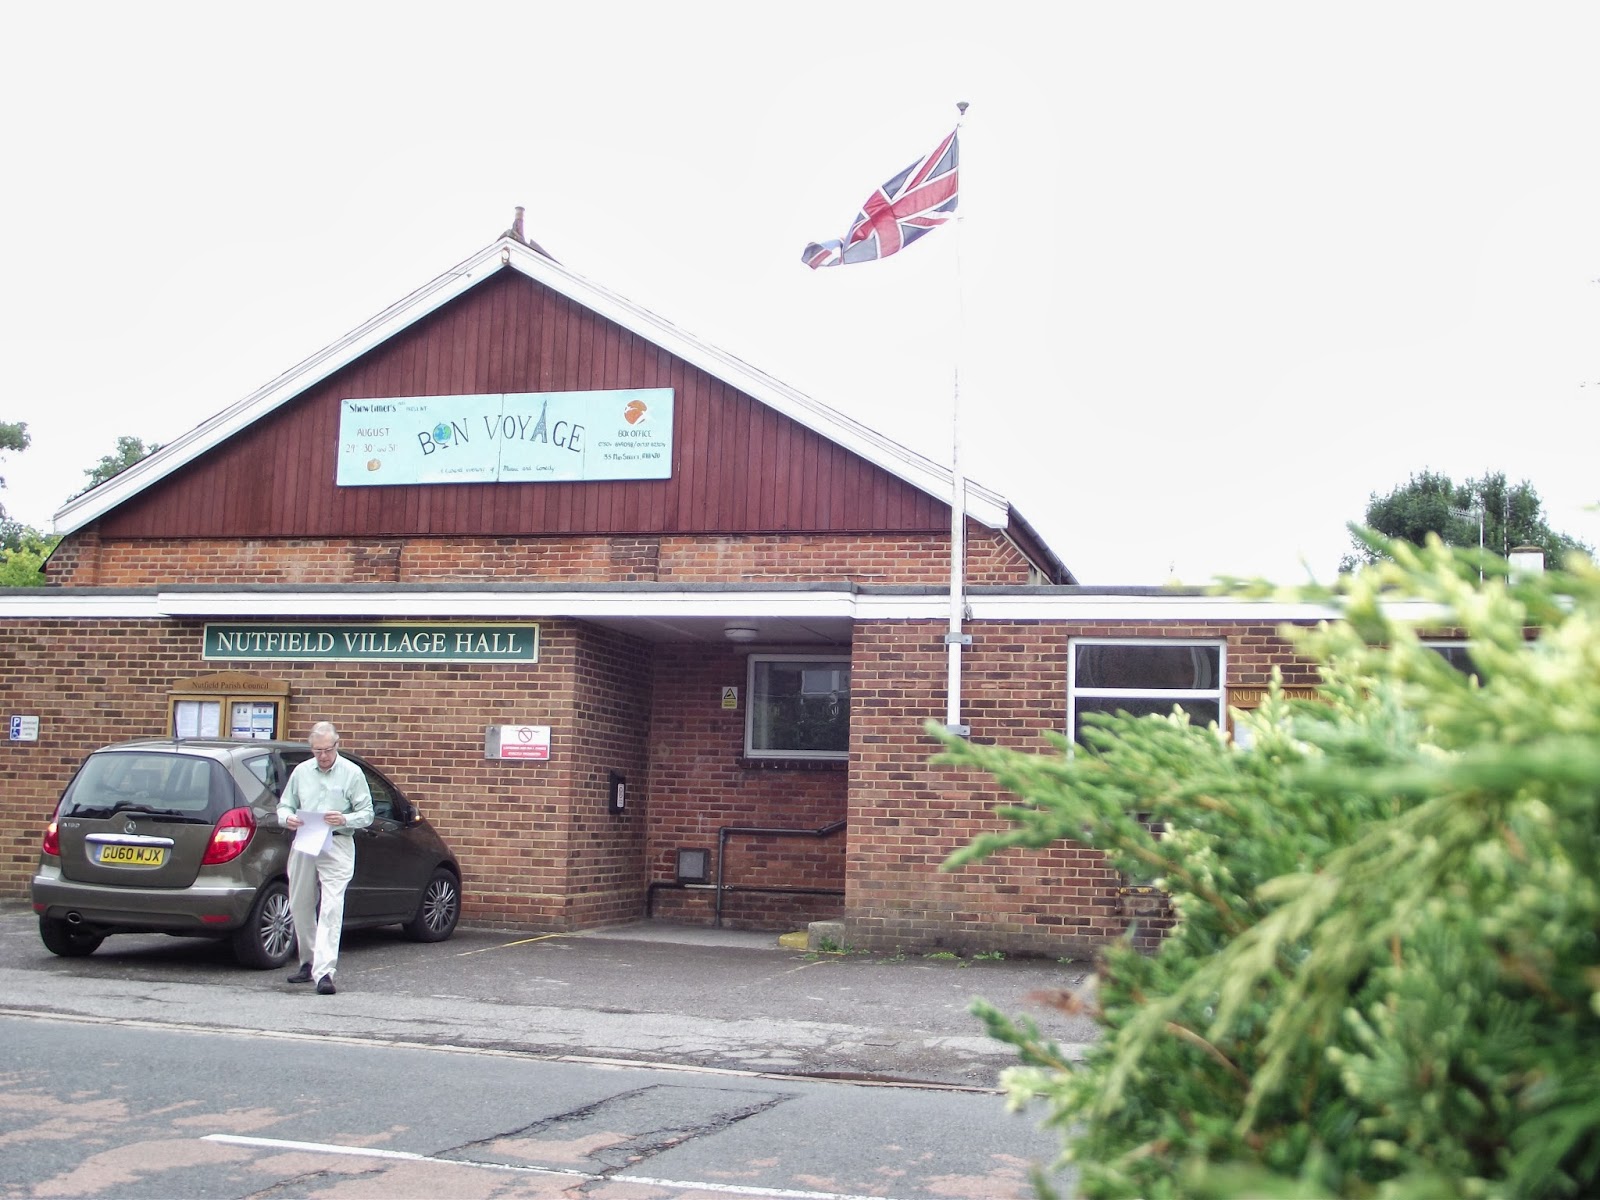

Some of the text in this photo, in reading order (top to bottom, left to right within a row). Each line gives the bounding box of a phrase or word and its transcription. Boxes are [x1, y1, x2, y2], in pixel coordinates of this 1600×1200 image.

[356, 427, 390, 437] AUGUST
[630, 429, 652, 438] OFFICE
[216, 631, 522, 655] NUTFIELD VILLAGE HALL
[192, 681, 269, 690] Nutfield Parish Council
[102, 845, 163, 862] GU60 MJX
